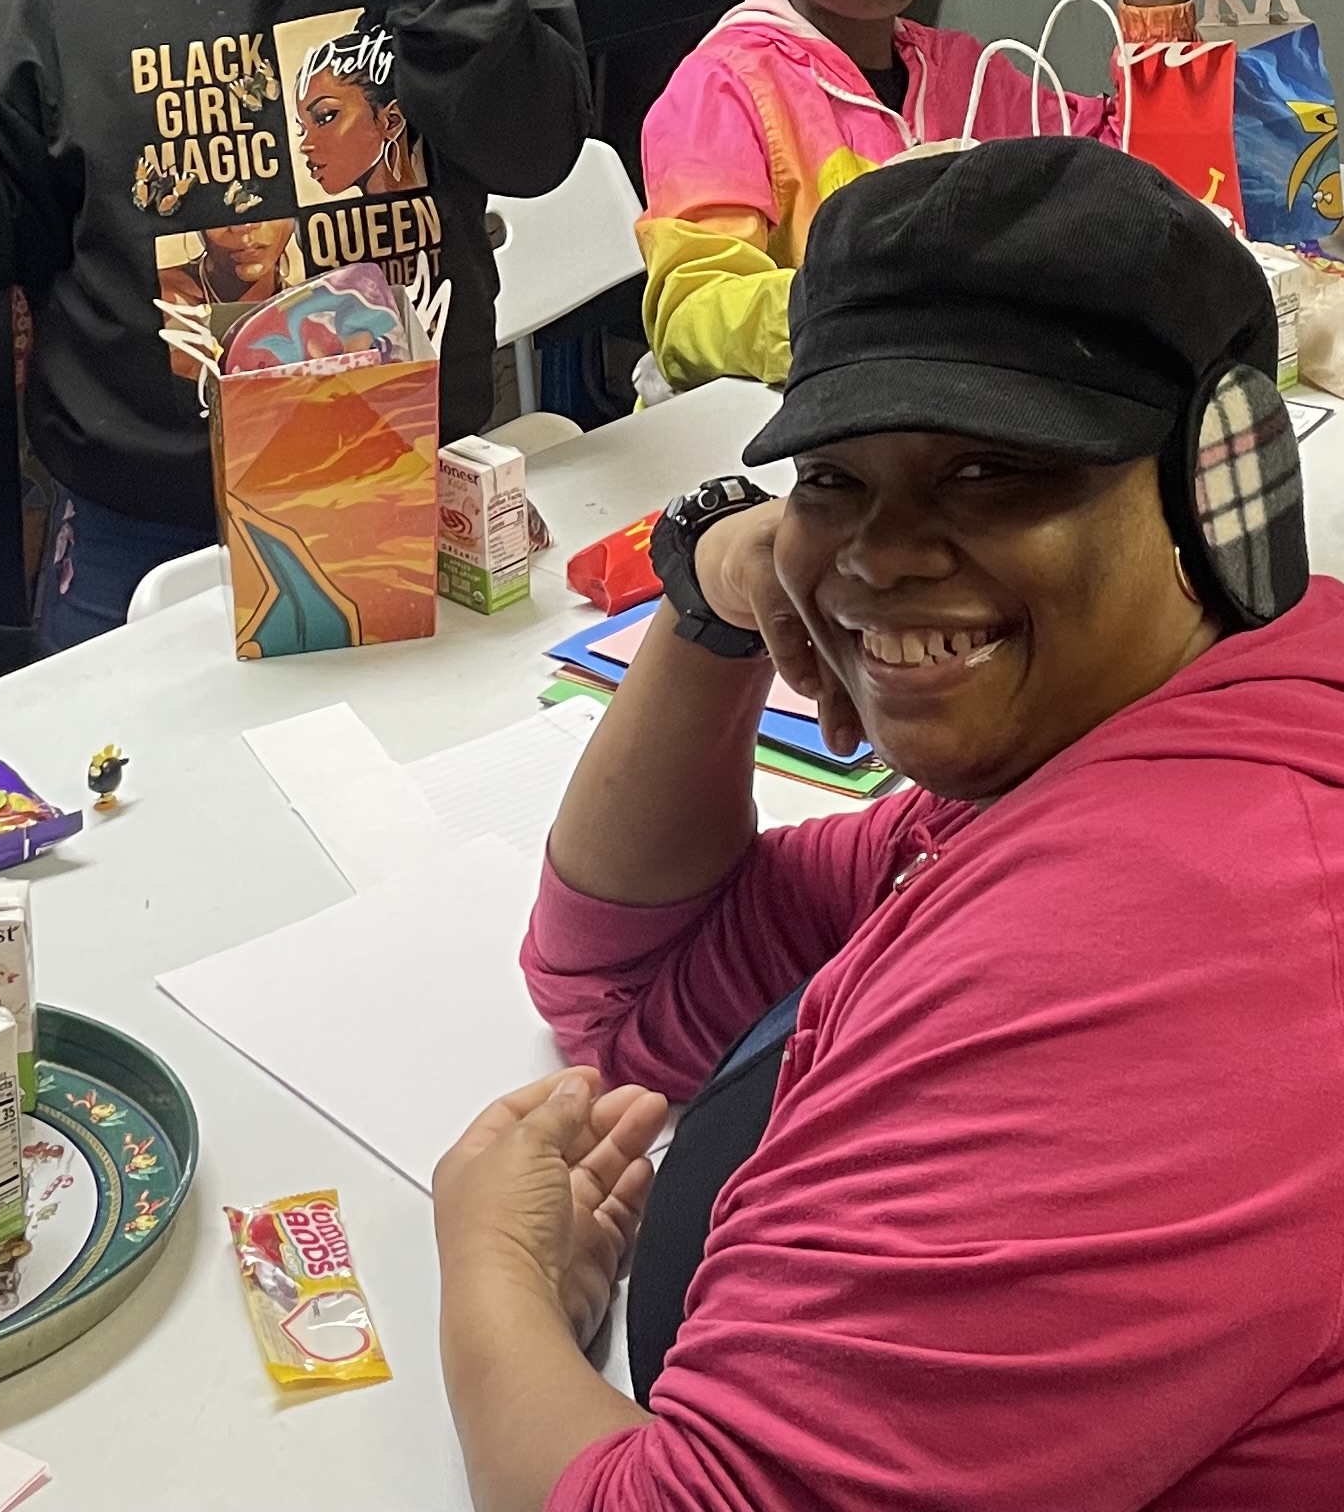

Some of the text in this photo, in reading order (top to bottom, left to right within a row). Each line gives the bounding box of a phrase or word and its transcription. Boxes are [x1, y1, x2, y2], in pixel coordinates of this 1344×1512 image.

[131, 33, 265, 94] BLACK
[295, 24, 395, 100] Pretty
[156, 87, 254, 139] GIRL
[144, 130, 279, 185] MAGIC
[308, 196, 442, 267] QUEEN
[2, 1105, 15, 1121] 35
